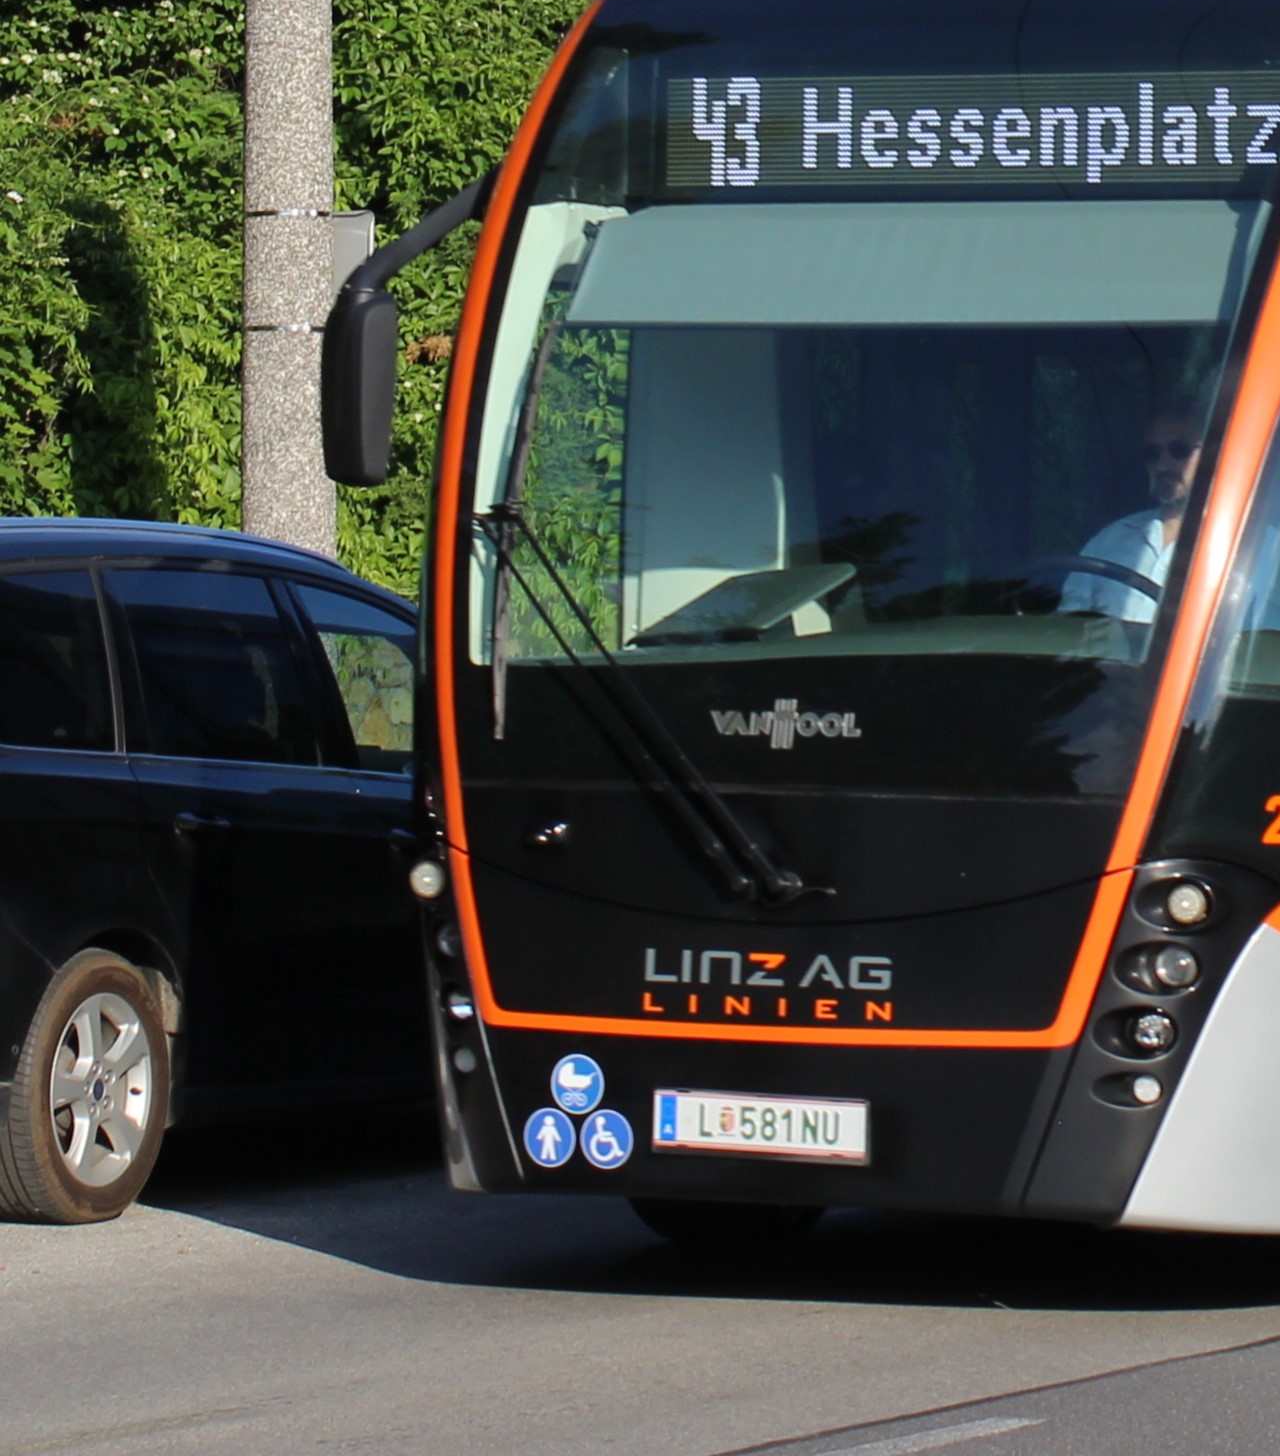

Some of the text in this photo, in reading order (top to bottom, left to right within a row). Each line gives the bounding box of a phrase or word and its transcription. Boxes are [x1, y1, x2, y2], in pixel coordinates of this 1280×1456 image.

[691, 76, 761, 187] 43
[644, 948, 893, 991] LINZ AG
[642, 992, 893, 1022] LINIEN
